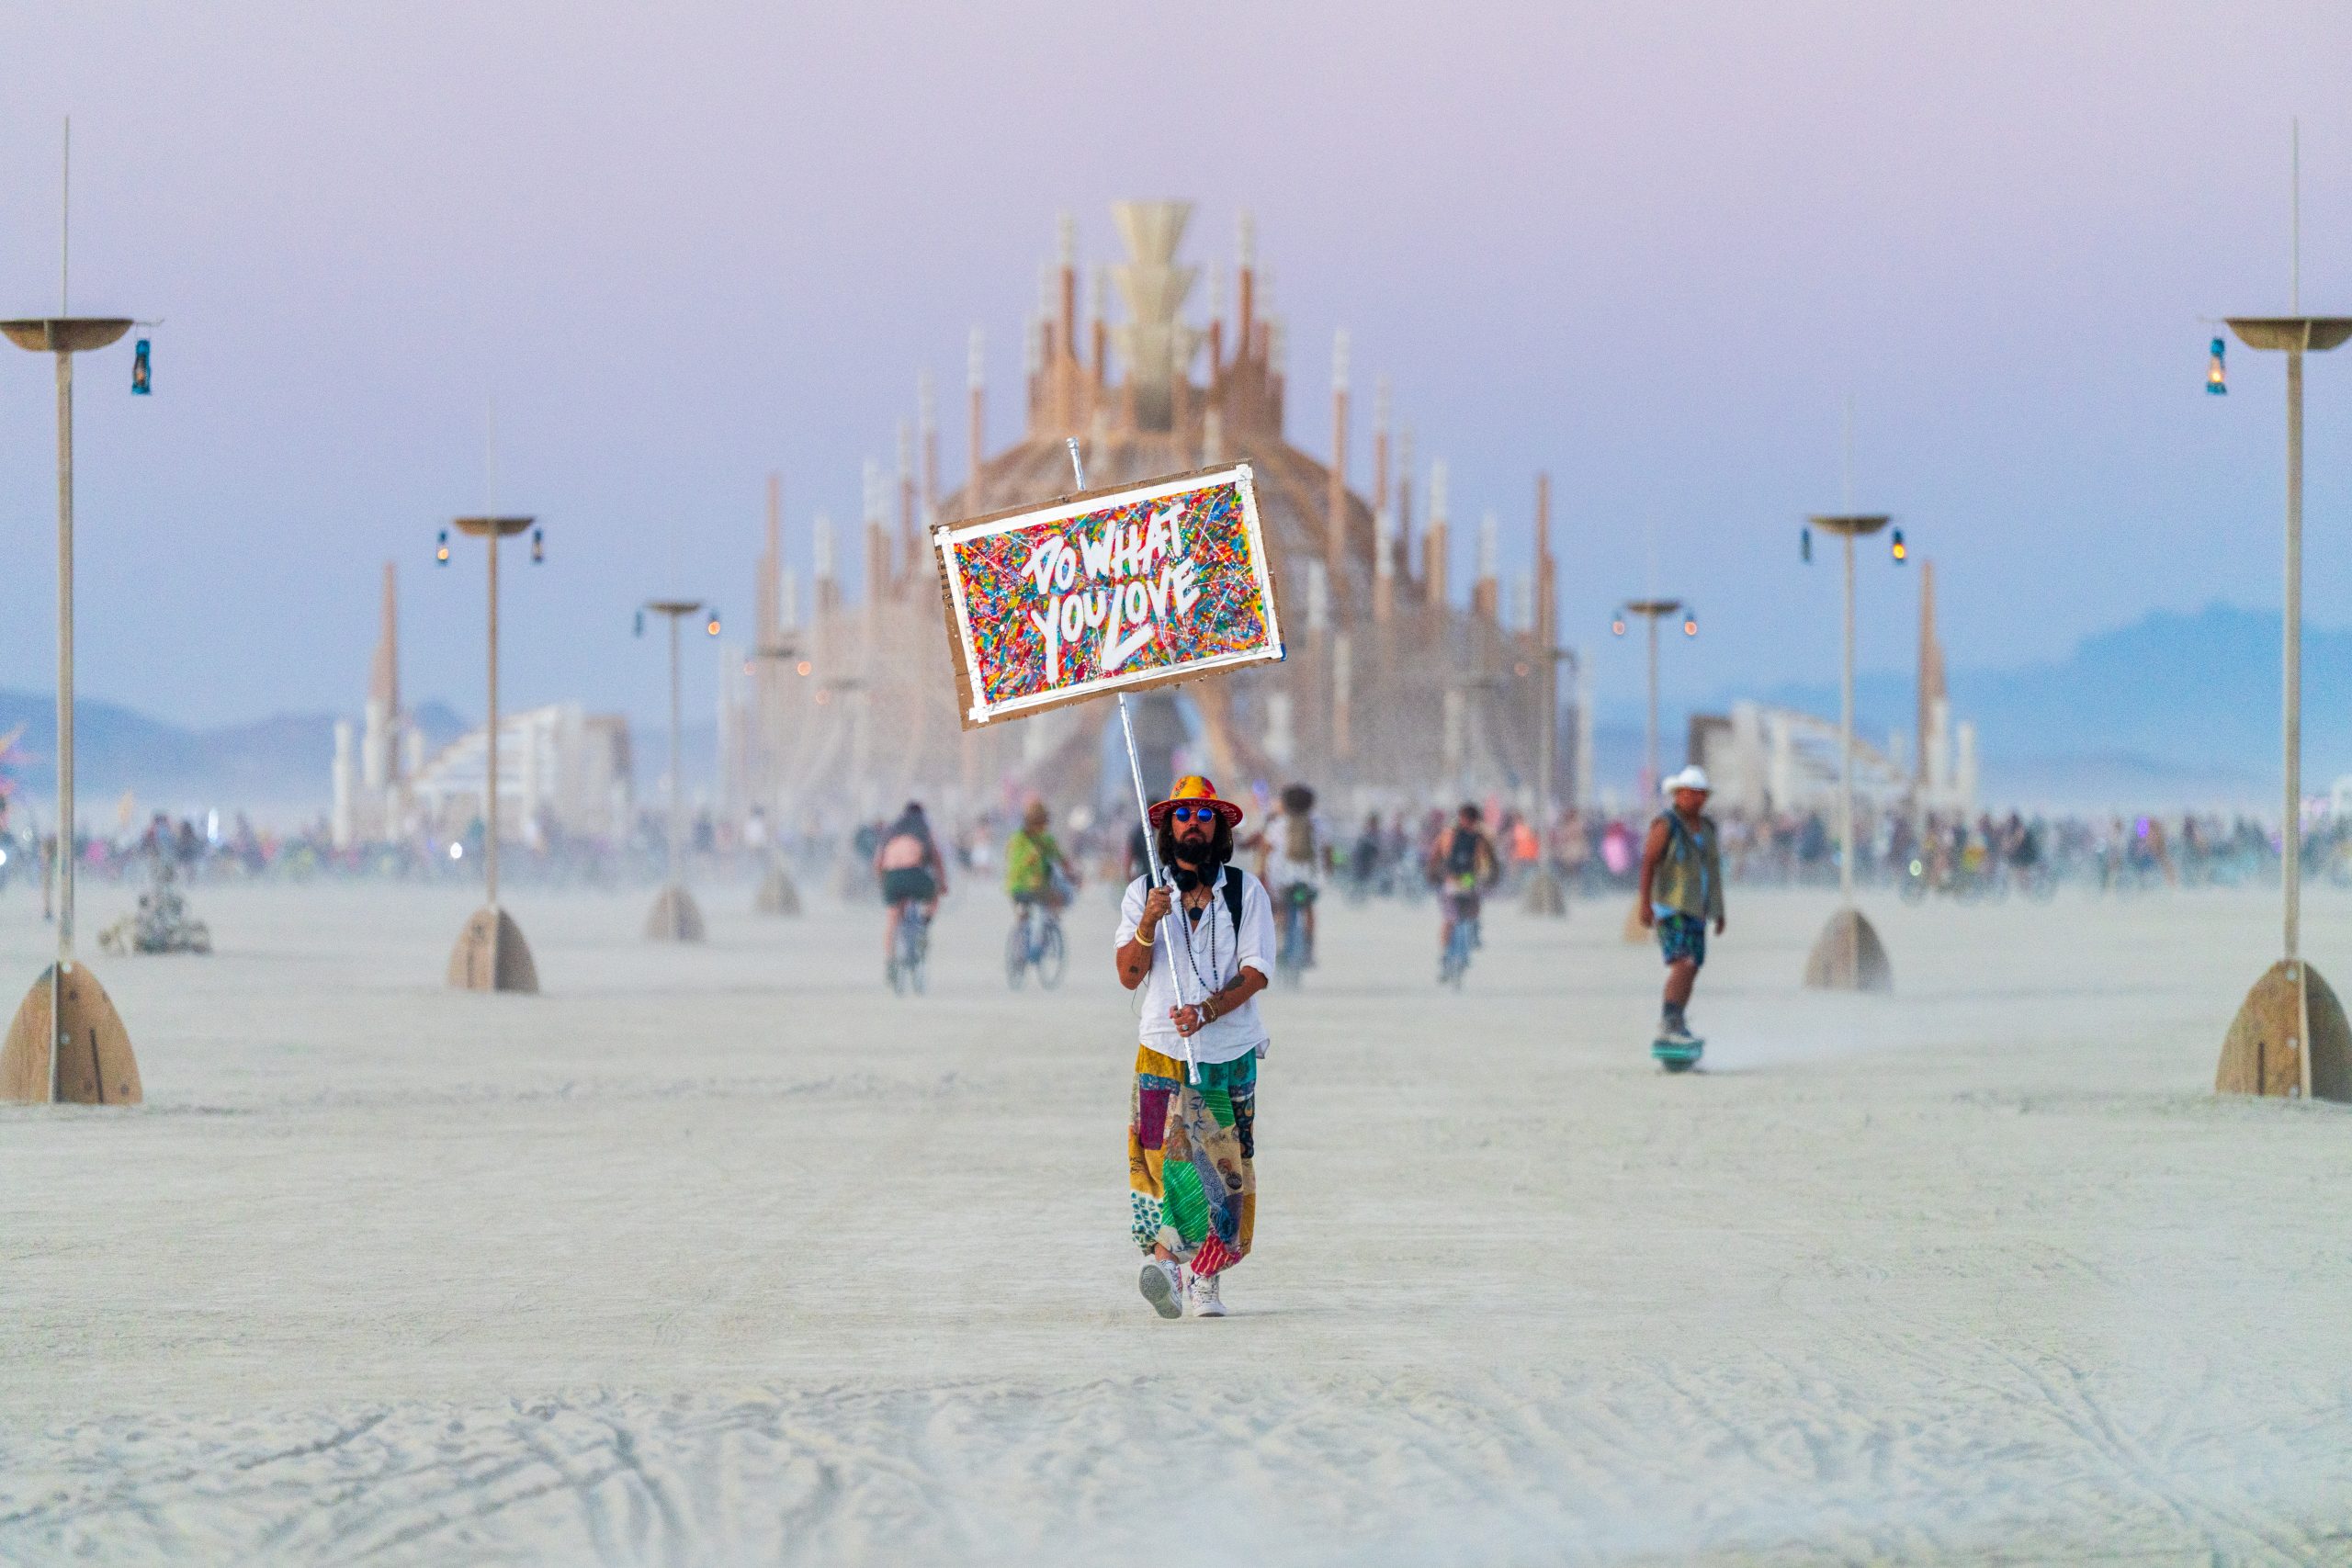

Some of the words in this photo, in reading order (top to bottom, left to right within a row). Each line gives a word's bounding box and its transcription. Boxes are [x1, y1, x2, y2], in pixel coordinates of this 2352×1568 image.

[1022, 536, 1076, 594] DO
[1080, 502, 1187, 579] WHAT
[1031, 588, 1106, 683] YOU
[1101, 558, 1200, 671] LOVE
